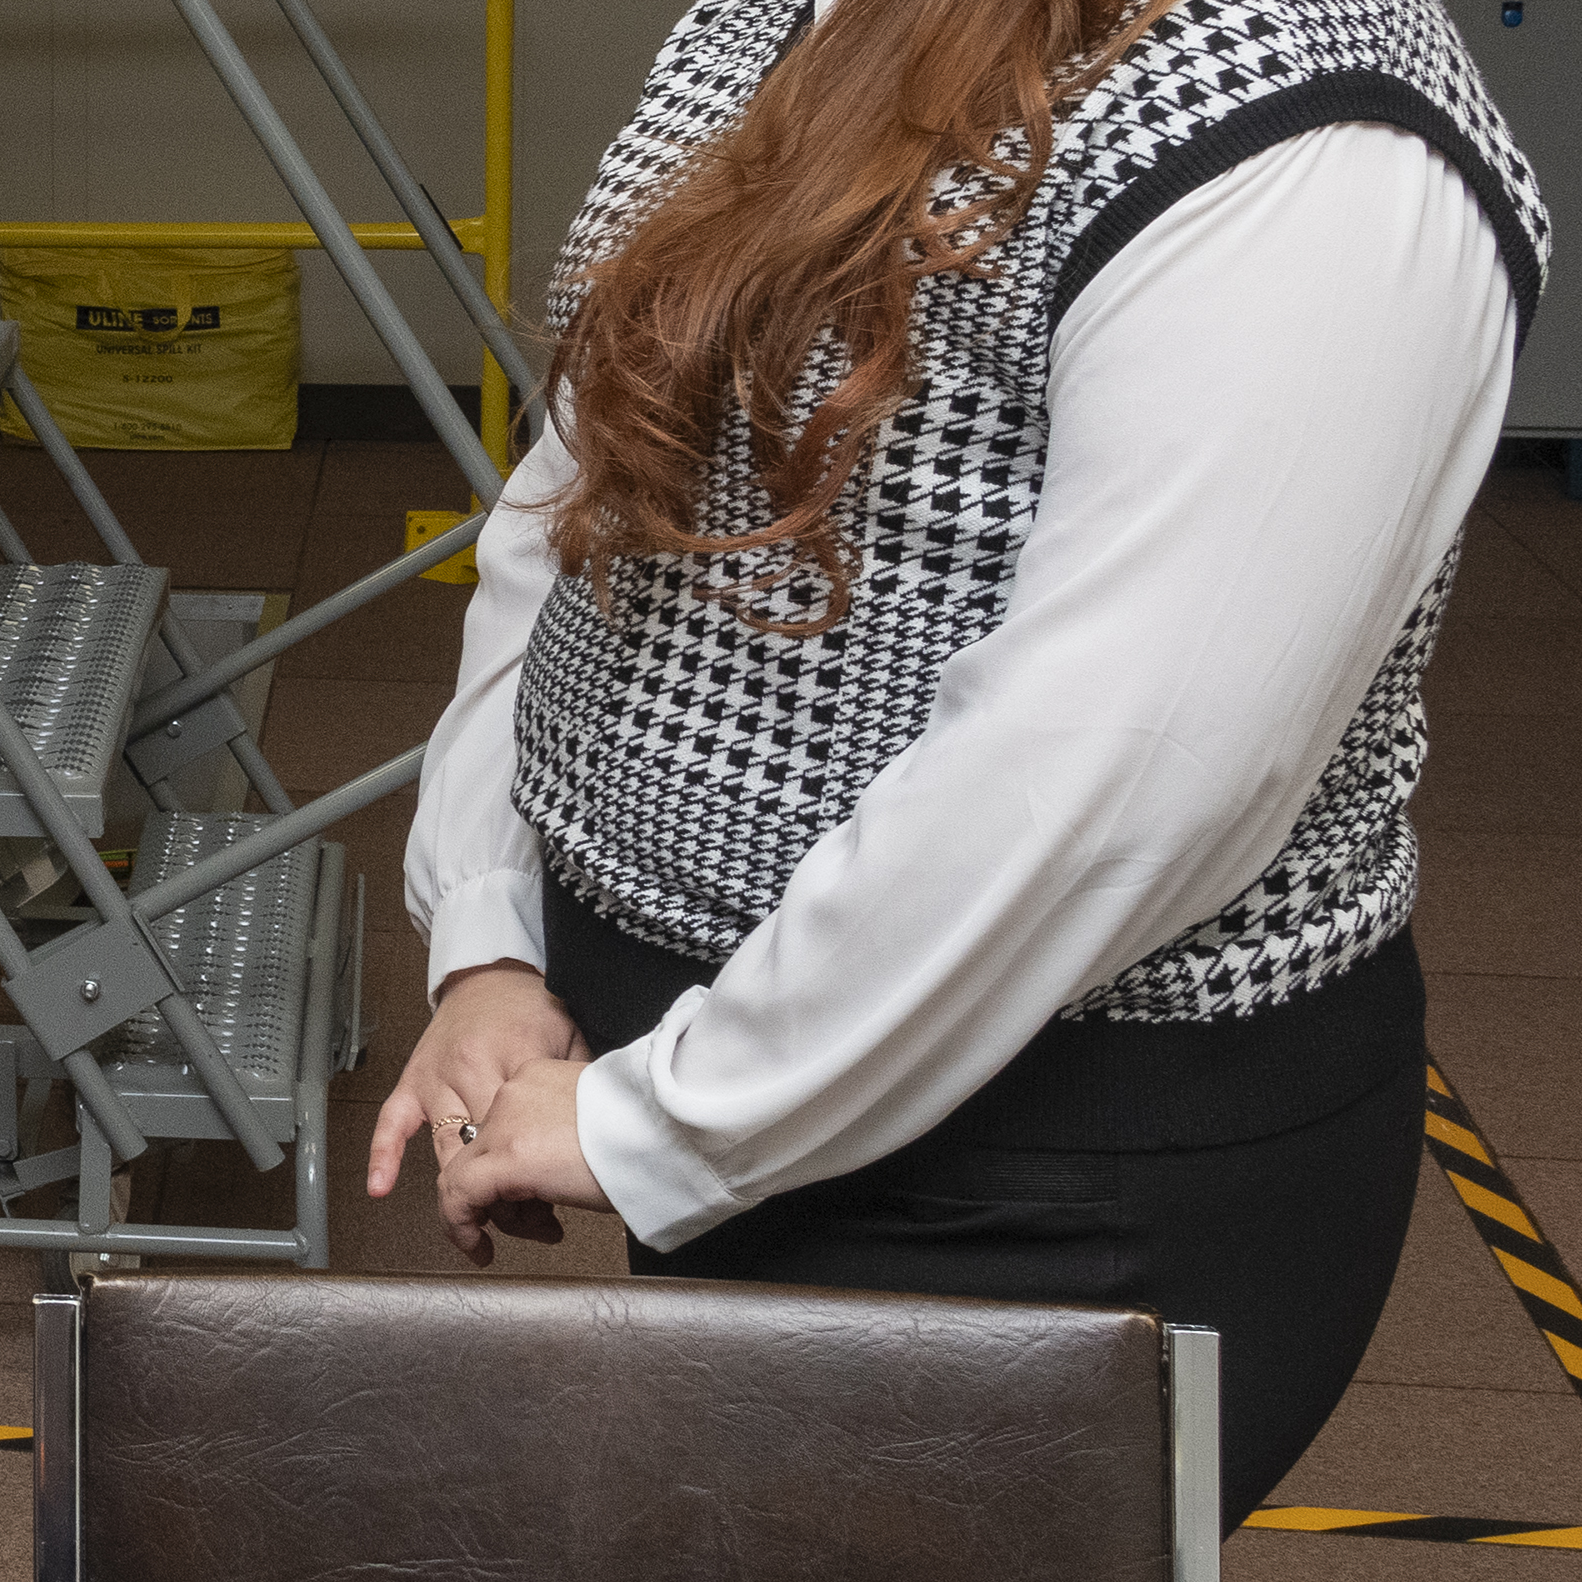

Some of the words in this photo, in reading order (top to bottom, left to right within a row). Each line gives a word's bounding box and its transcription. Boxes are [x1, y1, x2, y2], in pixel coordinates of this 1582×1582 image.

[88, 310, 143, 327] ULINE
[153, 313, 213, 325] SORNTS
[96, 344, 152, 355] UNIVERSAL
[157, 344, 183, 355] SPILL
[187, 344, 202, 354] KIT
[122, 375, 173, 383] S-12200
